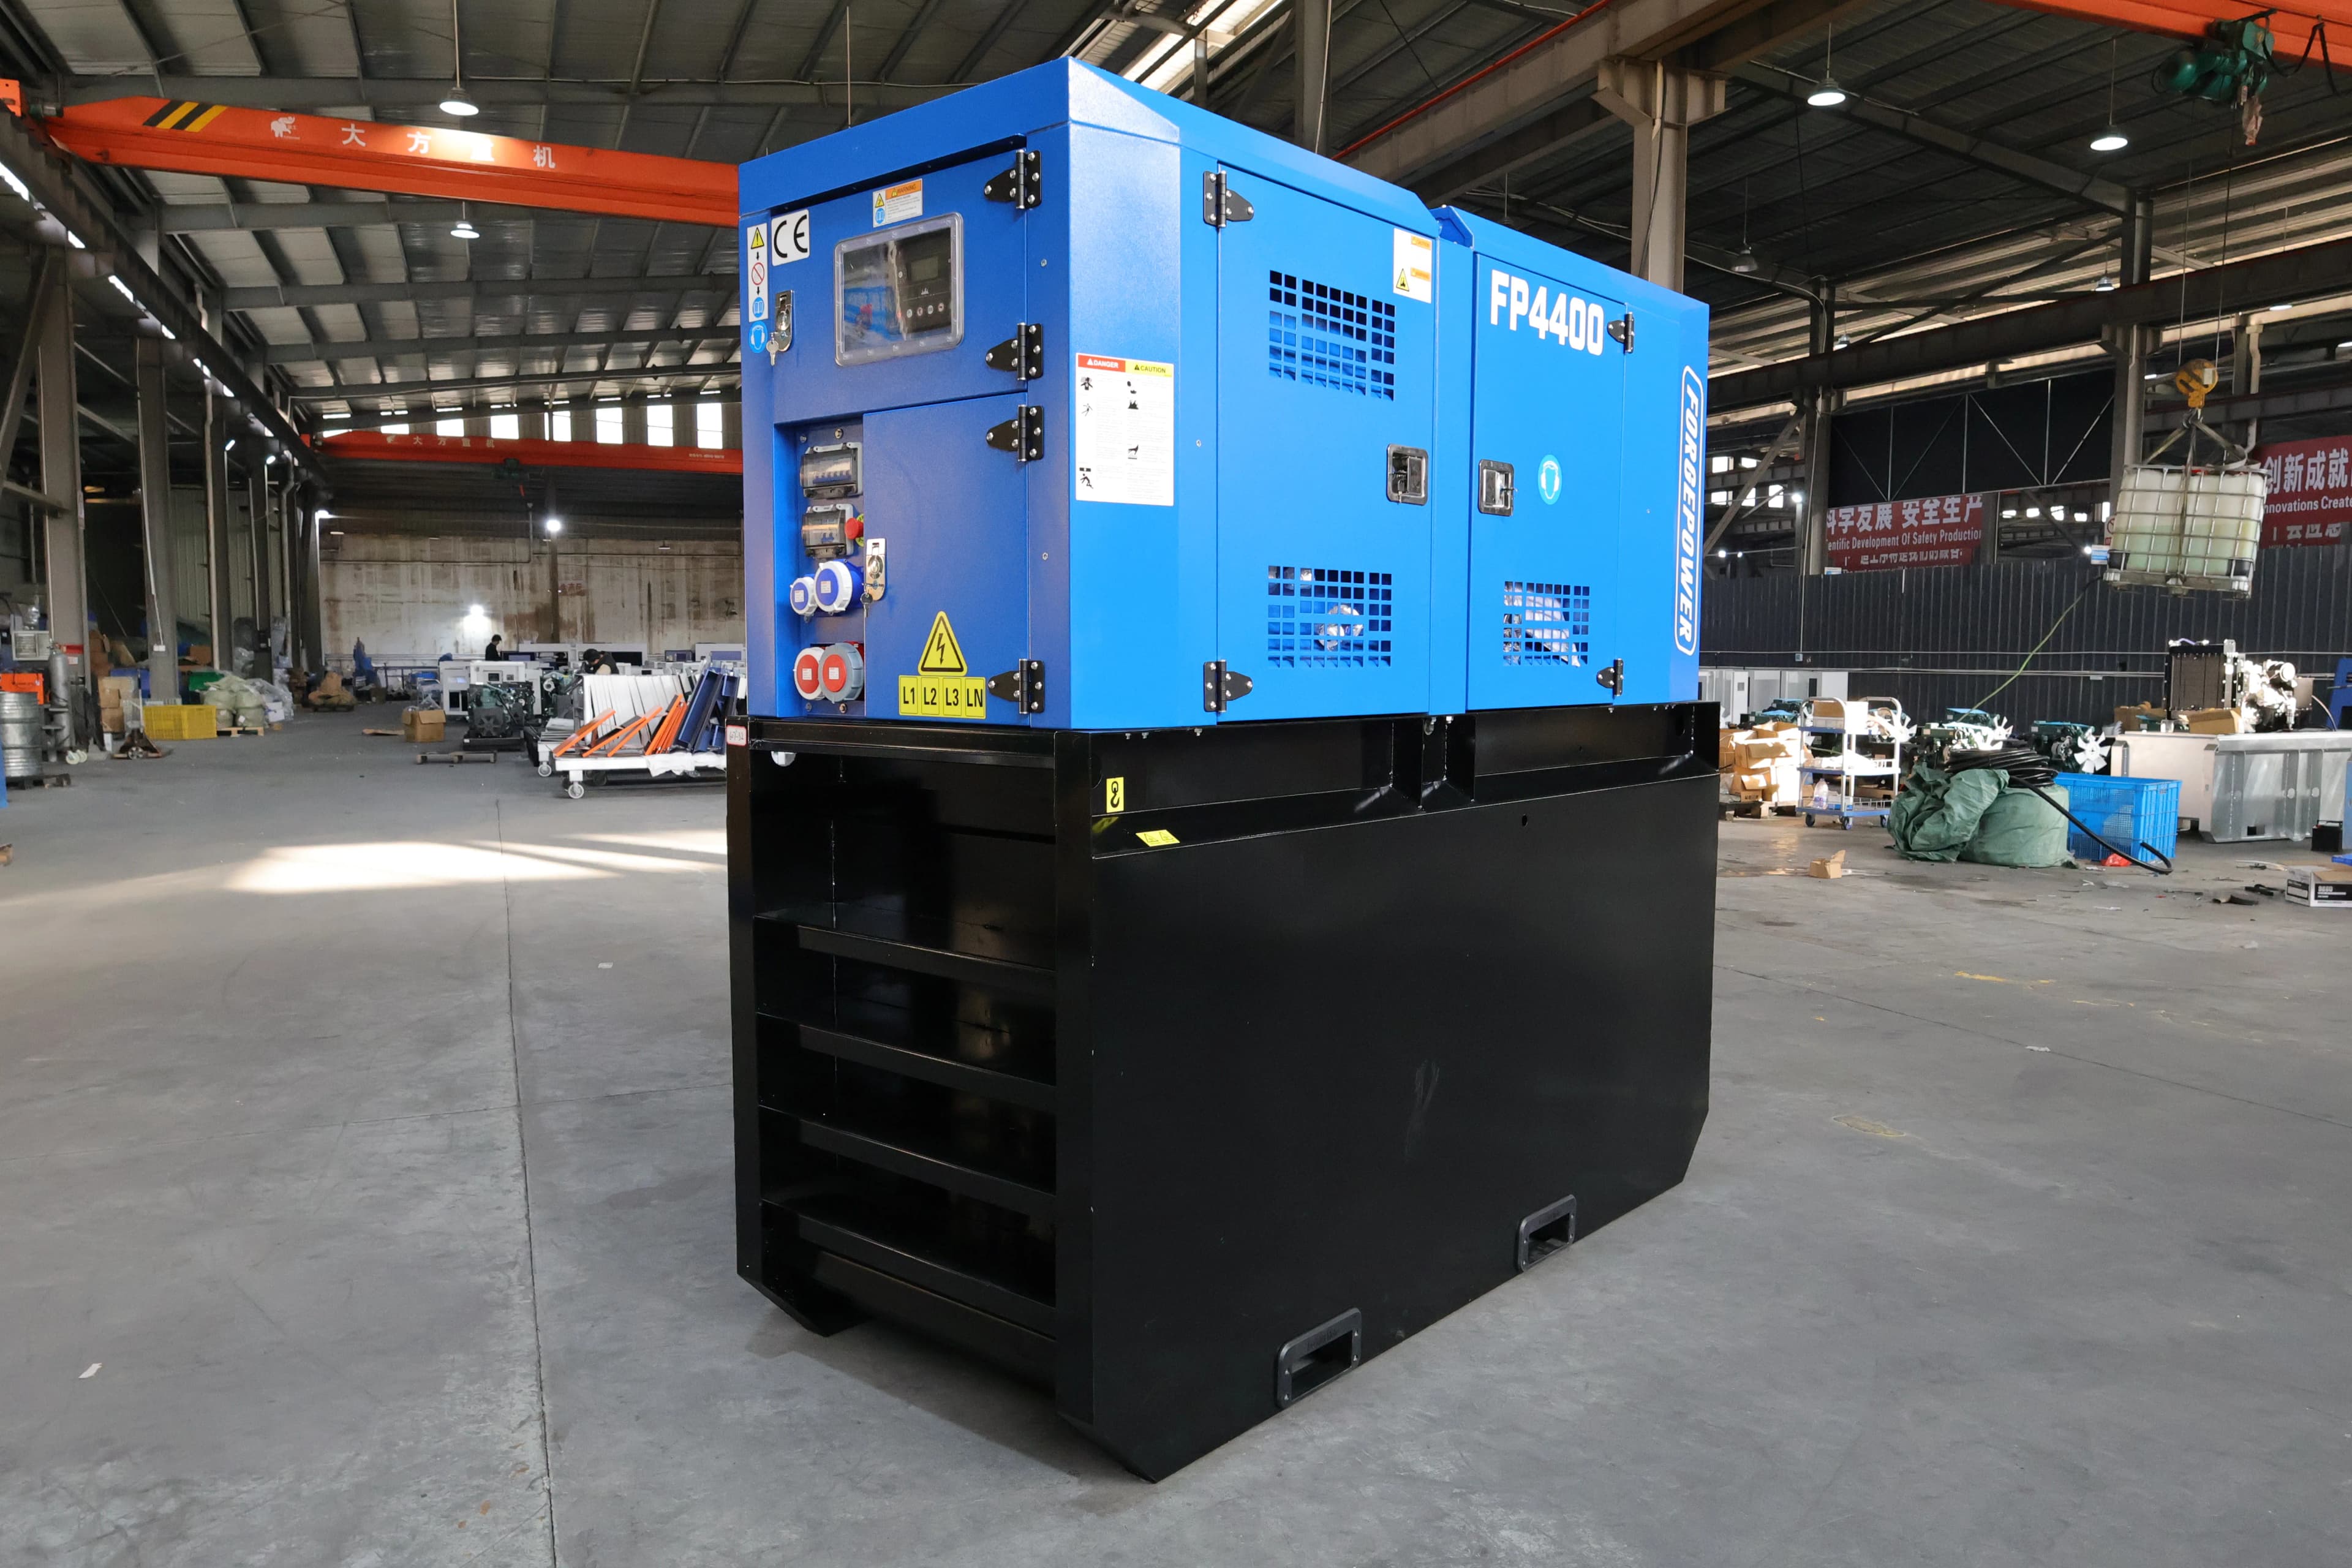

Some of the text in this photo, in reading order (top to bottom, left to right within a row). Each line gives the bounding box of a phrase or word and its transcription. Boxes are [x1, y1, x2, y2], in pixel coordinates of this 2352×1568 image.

[774, 214, 808, 258] CE
[1490, 269, 1604, 356] FP4400
[1093, 359, 1118, 368] DANGER
[2263, 448, 2352, 494] 创新成就
[1679, 384, 1698, 642] FORGEPOWER
[2263, 499, 2319, 514] nnovations
[1826, 527, 1981, 551] entific Development Of Safety Productio
[903, 686, 983, 707] L1 L2 L3 LN
